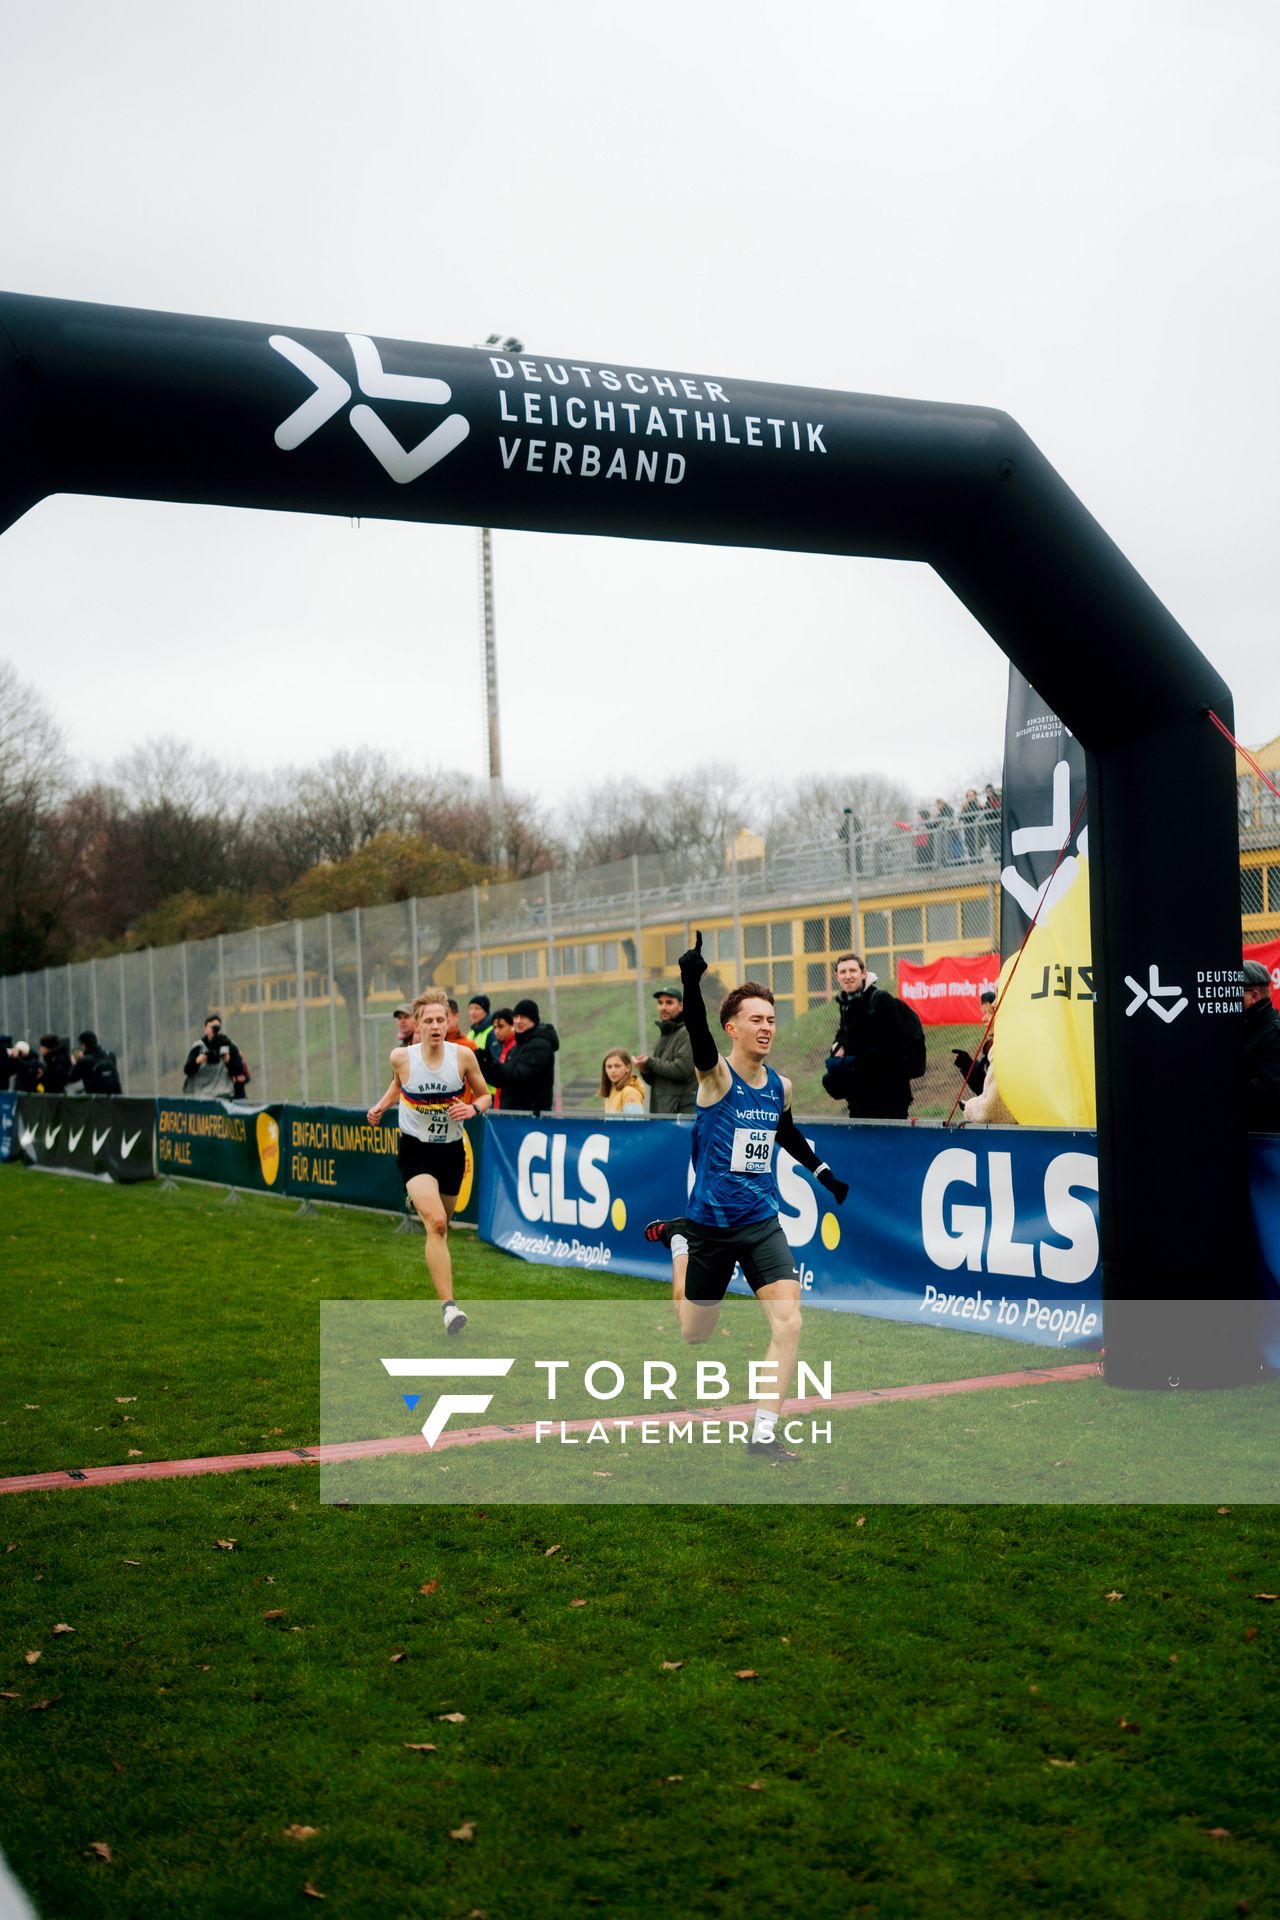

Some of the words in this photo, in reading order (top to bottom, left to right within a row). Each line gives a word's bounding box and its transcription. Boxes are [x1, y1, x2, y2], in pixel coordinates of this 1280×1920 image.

[489, 357, 730, 403] DEUTSCHER
[499, 390, 827, 453] LEICHTATHLETIK
[499, 436, 686, 484] VERBAND
[1198, 1001, 1243, 1014] VERBAND
[418, 1083, 448, 1092] HANAU
[428, 1123, 449, 1134] 471
[736, 1109, 779, 1122] watttron
[291, 1121, 329, 1149] EINFACH
[750, 1132, 767, 1141] GLS
[745, 1143, 769, 1160] 948
[291, 1151, 309, 1182] FÜR
[506, 1231, 552, 1257] Parcels
[552, 1238, 570, 1258] to
[567, 1239, 612, 1267] People
[920, 1285, 993, 1321] Parcels
[997, 1297, 1030, 1325] to
[1022, 1298, 1097, 1342] People
